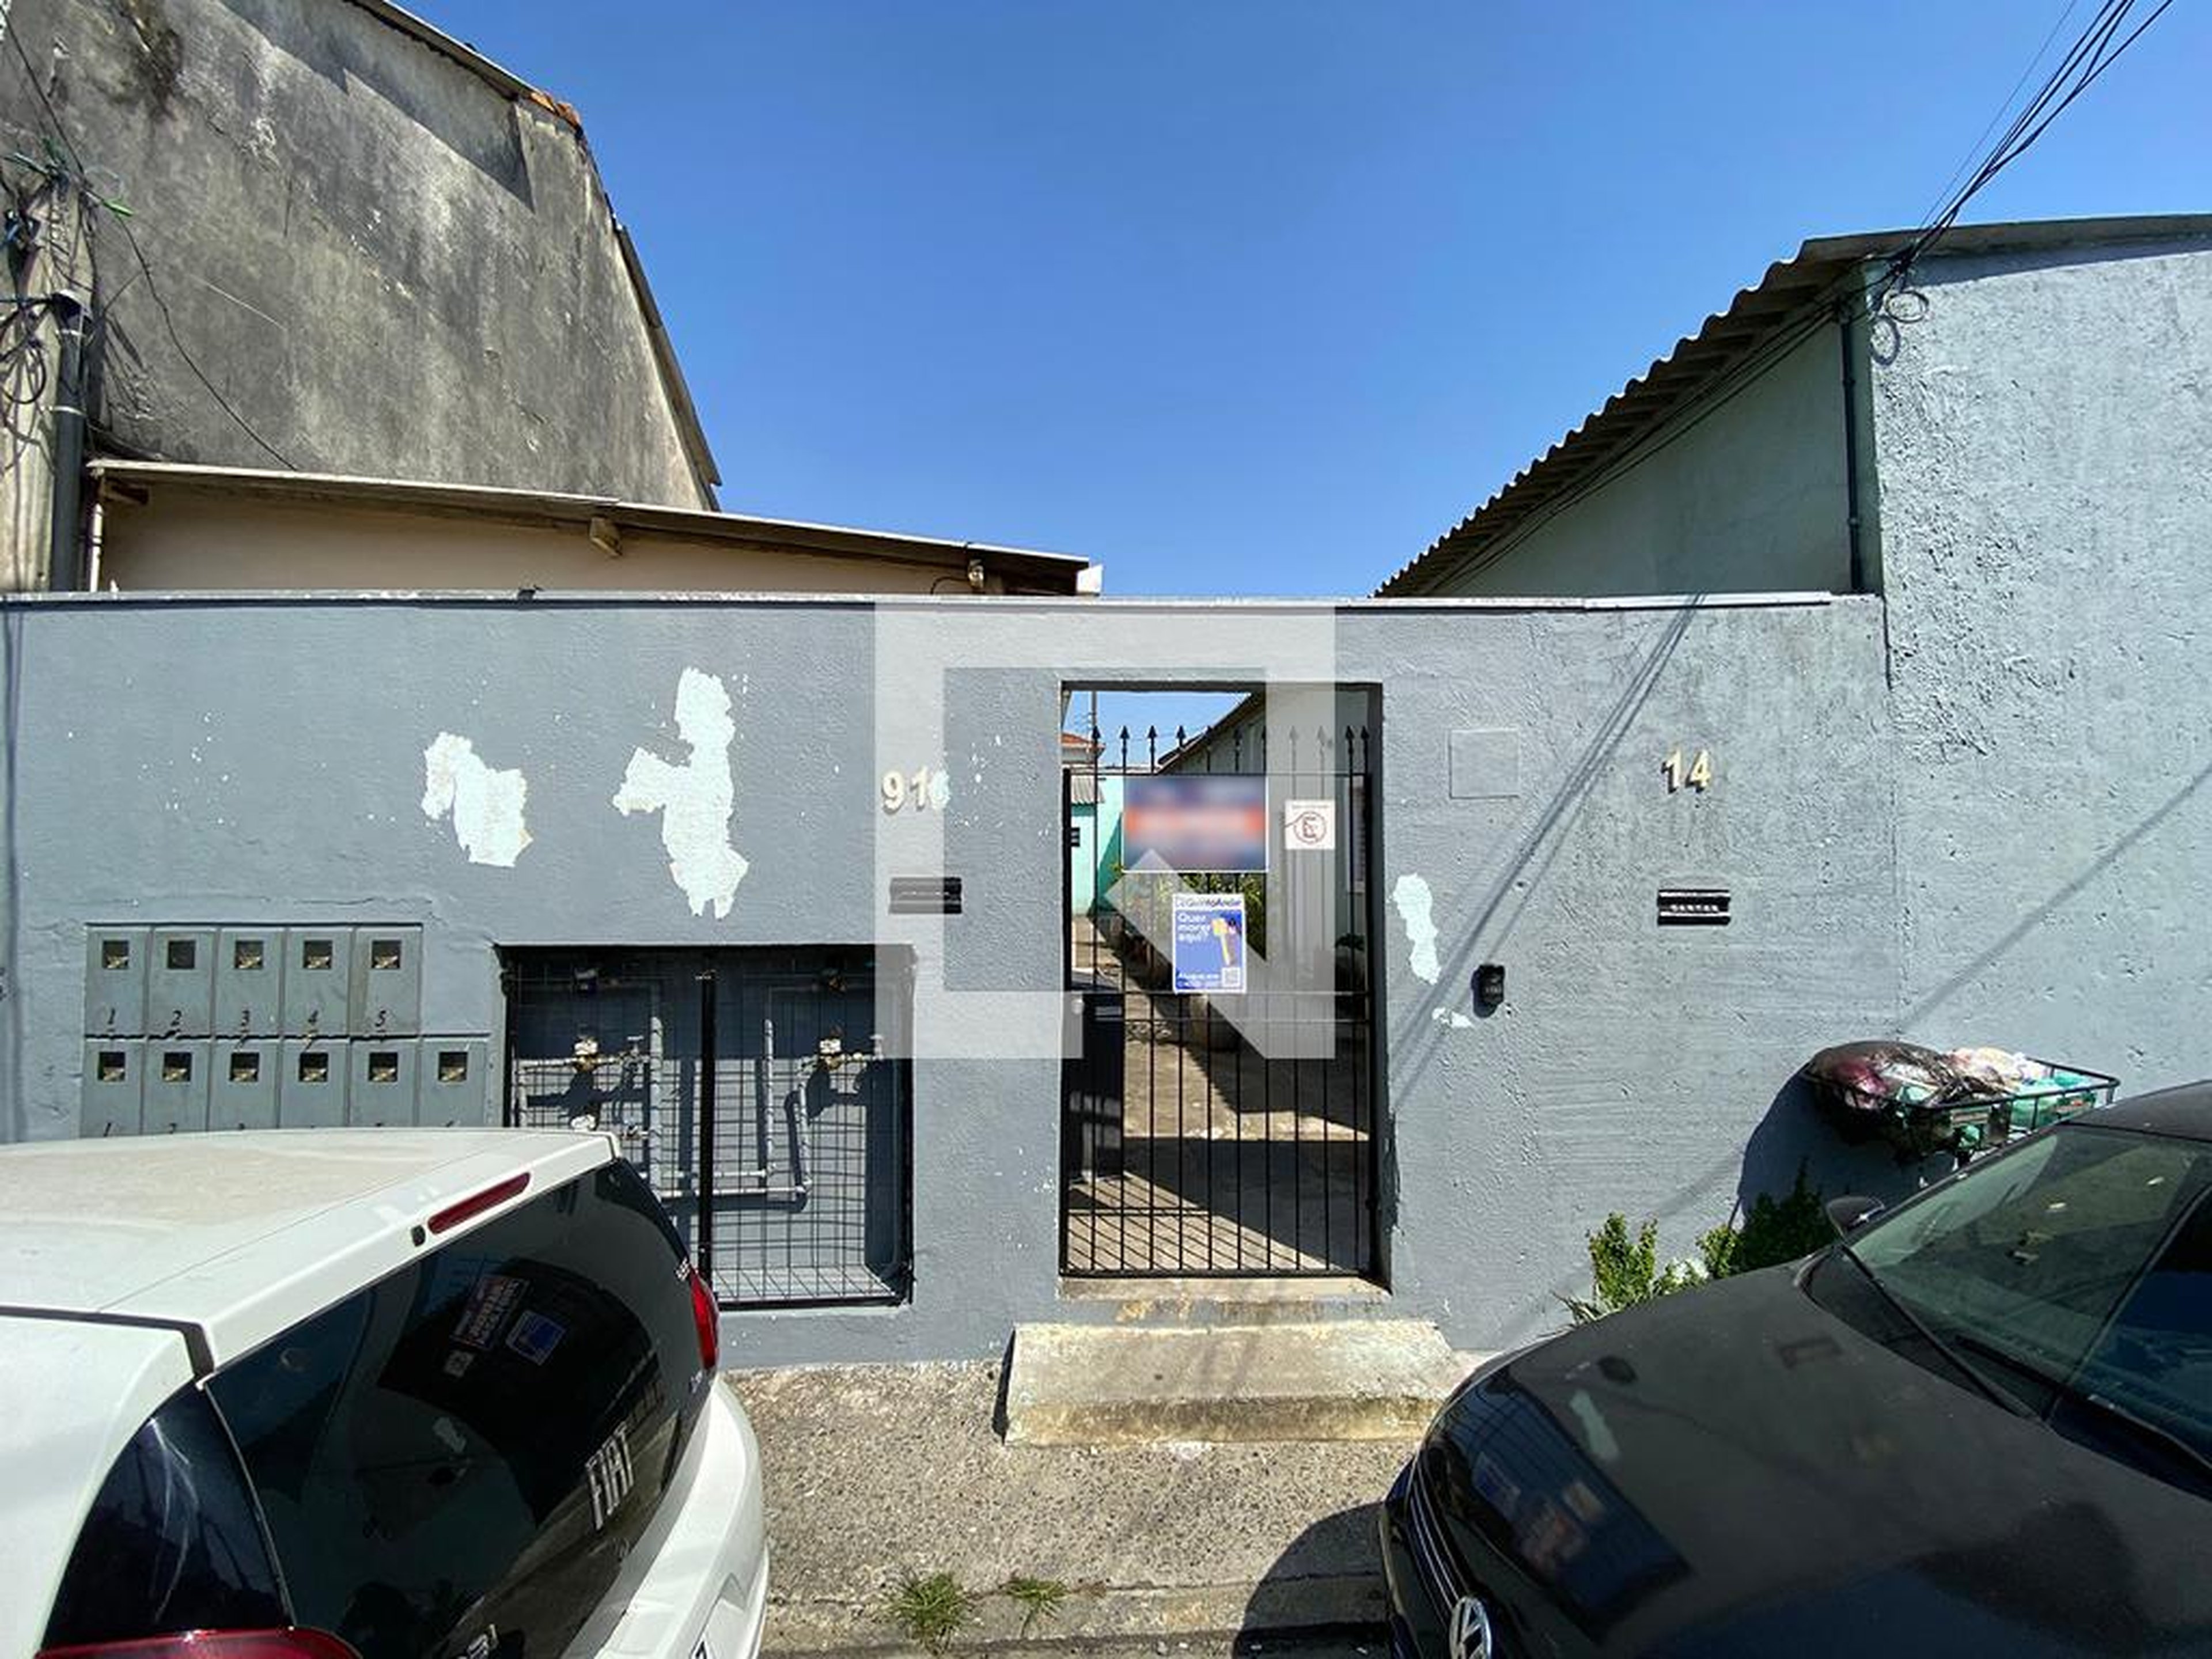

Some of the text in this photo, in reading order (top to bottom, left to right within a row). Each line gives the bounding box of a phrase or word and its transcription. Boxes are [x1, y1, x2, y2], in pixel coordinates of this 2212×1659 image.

[1661, 749, 1711, 794] 14
[107, 1009, 115, 1025] 1
[171, 1010, 182, 1027] 2
[240, 1010, 250, 1027] 3
[308, 1010, 318, 1024] 4
[375, 1010, 387, 1027] 5
[585, 1420, 634, 1530] FIAT
